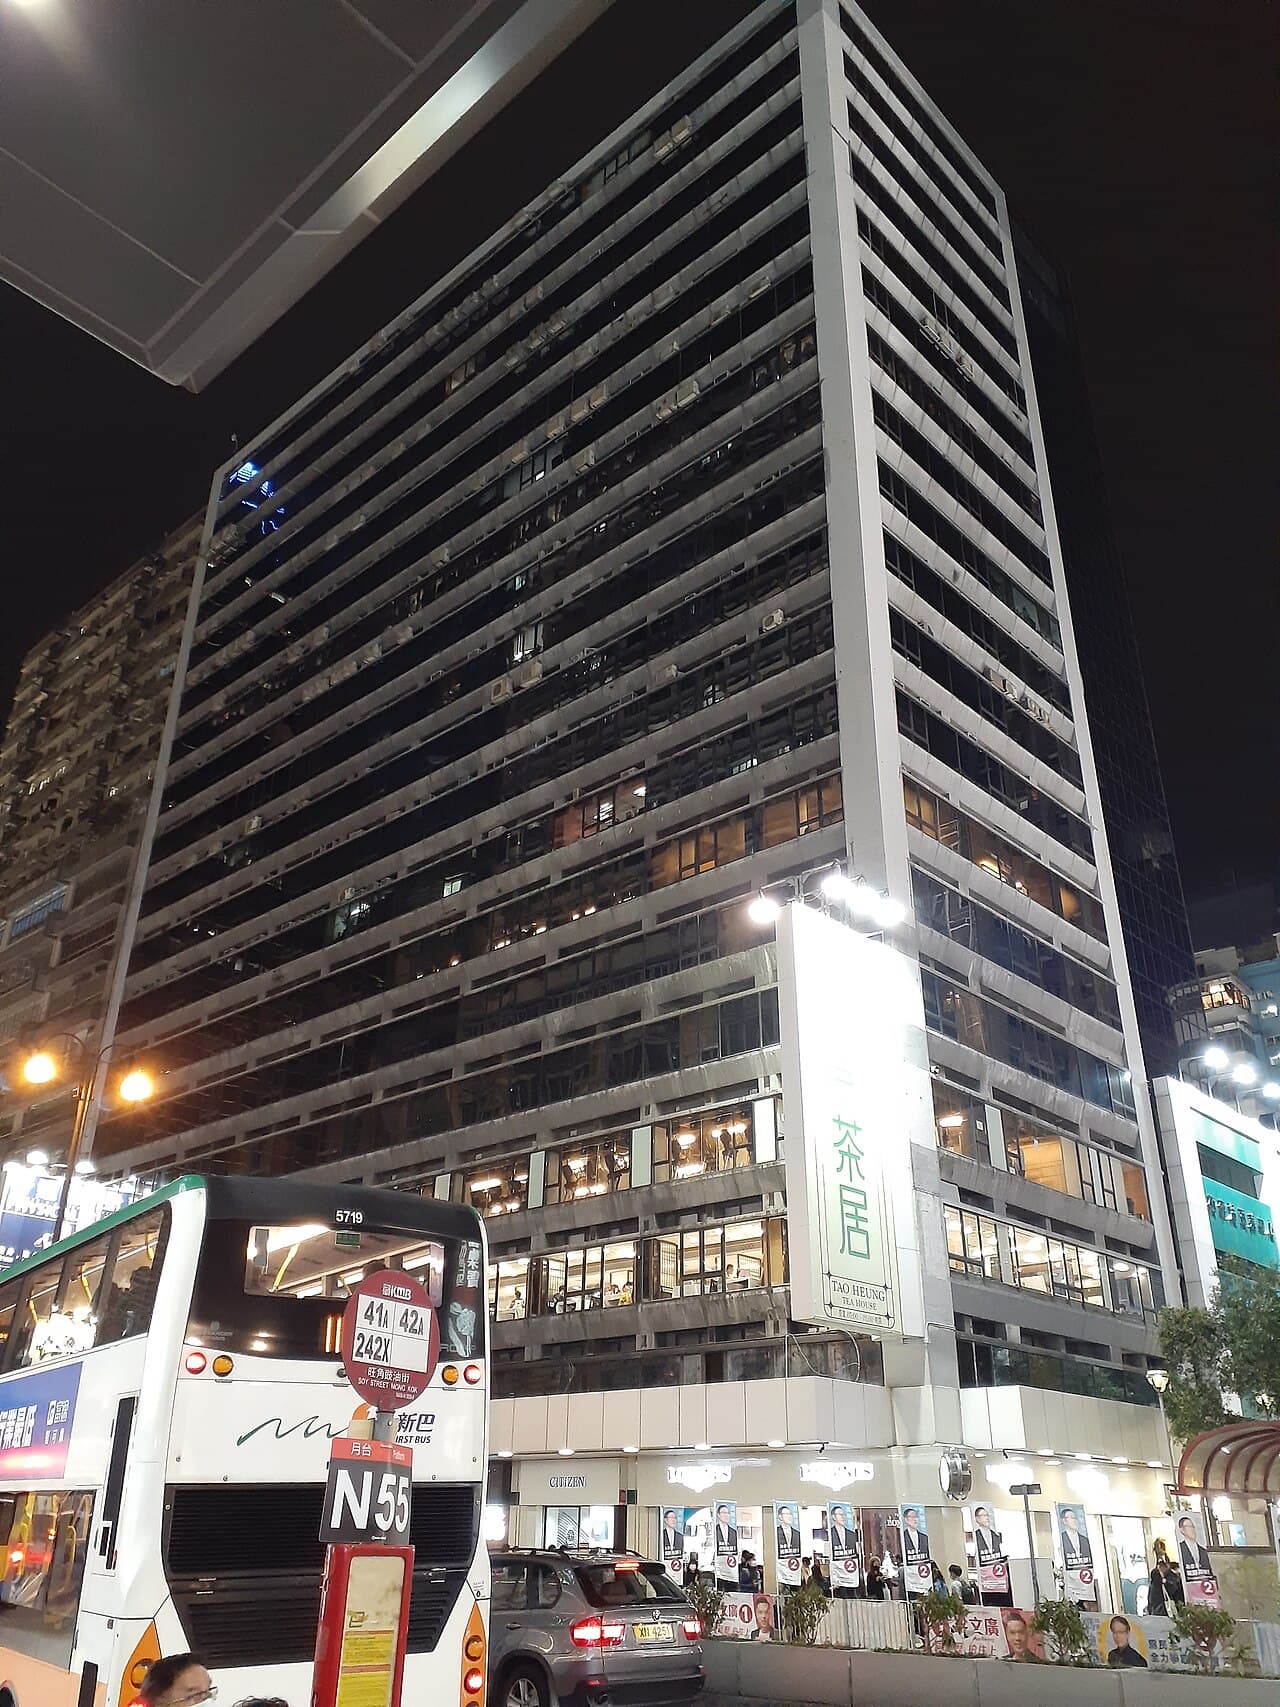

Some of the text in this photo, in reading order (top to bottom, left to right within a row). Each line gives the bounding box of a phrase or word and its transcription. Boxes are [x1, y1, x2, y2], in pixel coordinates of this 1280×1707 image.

[832, 1113, 870, 1260] 茶居
[335, 1210, 363, 1224] 5719
[832, 1280, 885, 1301] TAO HEUNG
[842, 1296, 878, 1311] TEA HOUSE
[364, 1301, 424, 1336] 41A 42A
[354, 1332, 390, 1363] 242X
[358, 1377, 418, 1393] SOY STREET MONG KOK
[397, 1412, 436, 1433] 新巴
[395, 1435, 431, 1444] IRST BUS
[351, 1442, 372, 1456] 月台
[549, 1476, 586, 1488] CITIZEN
